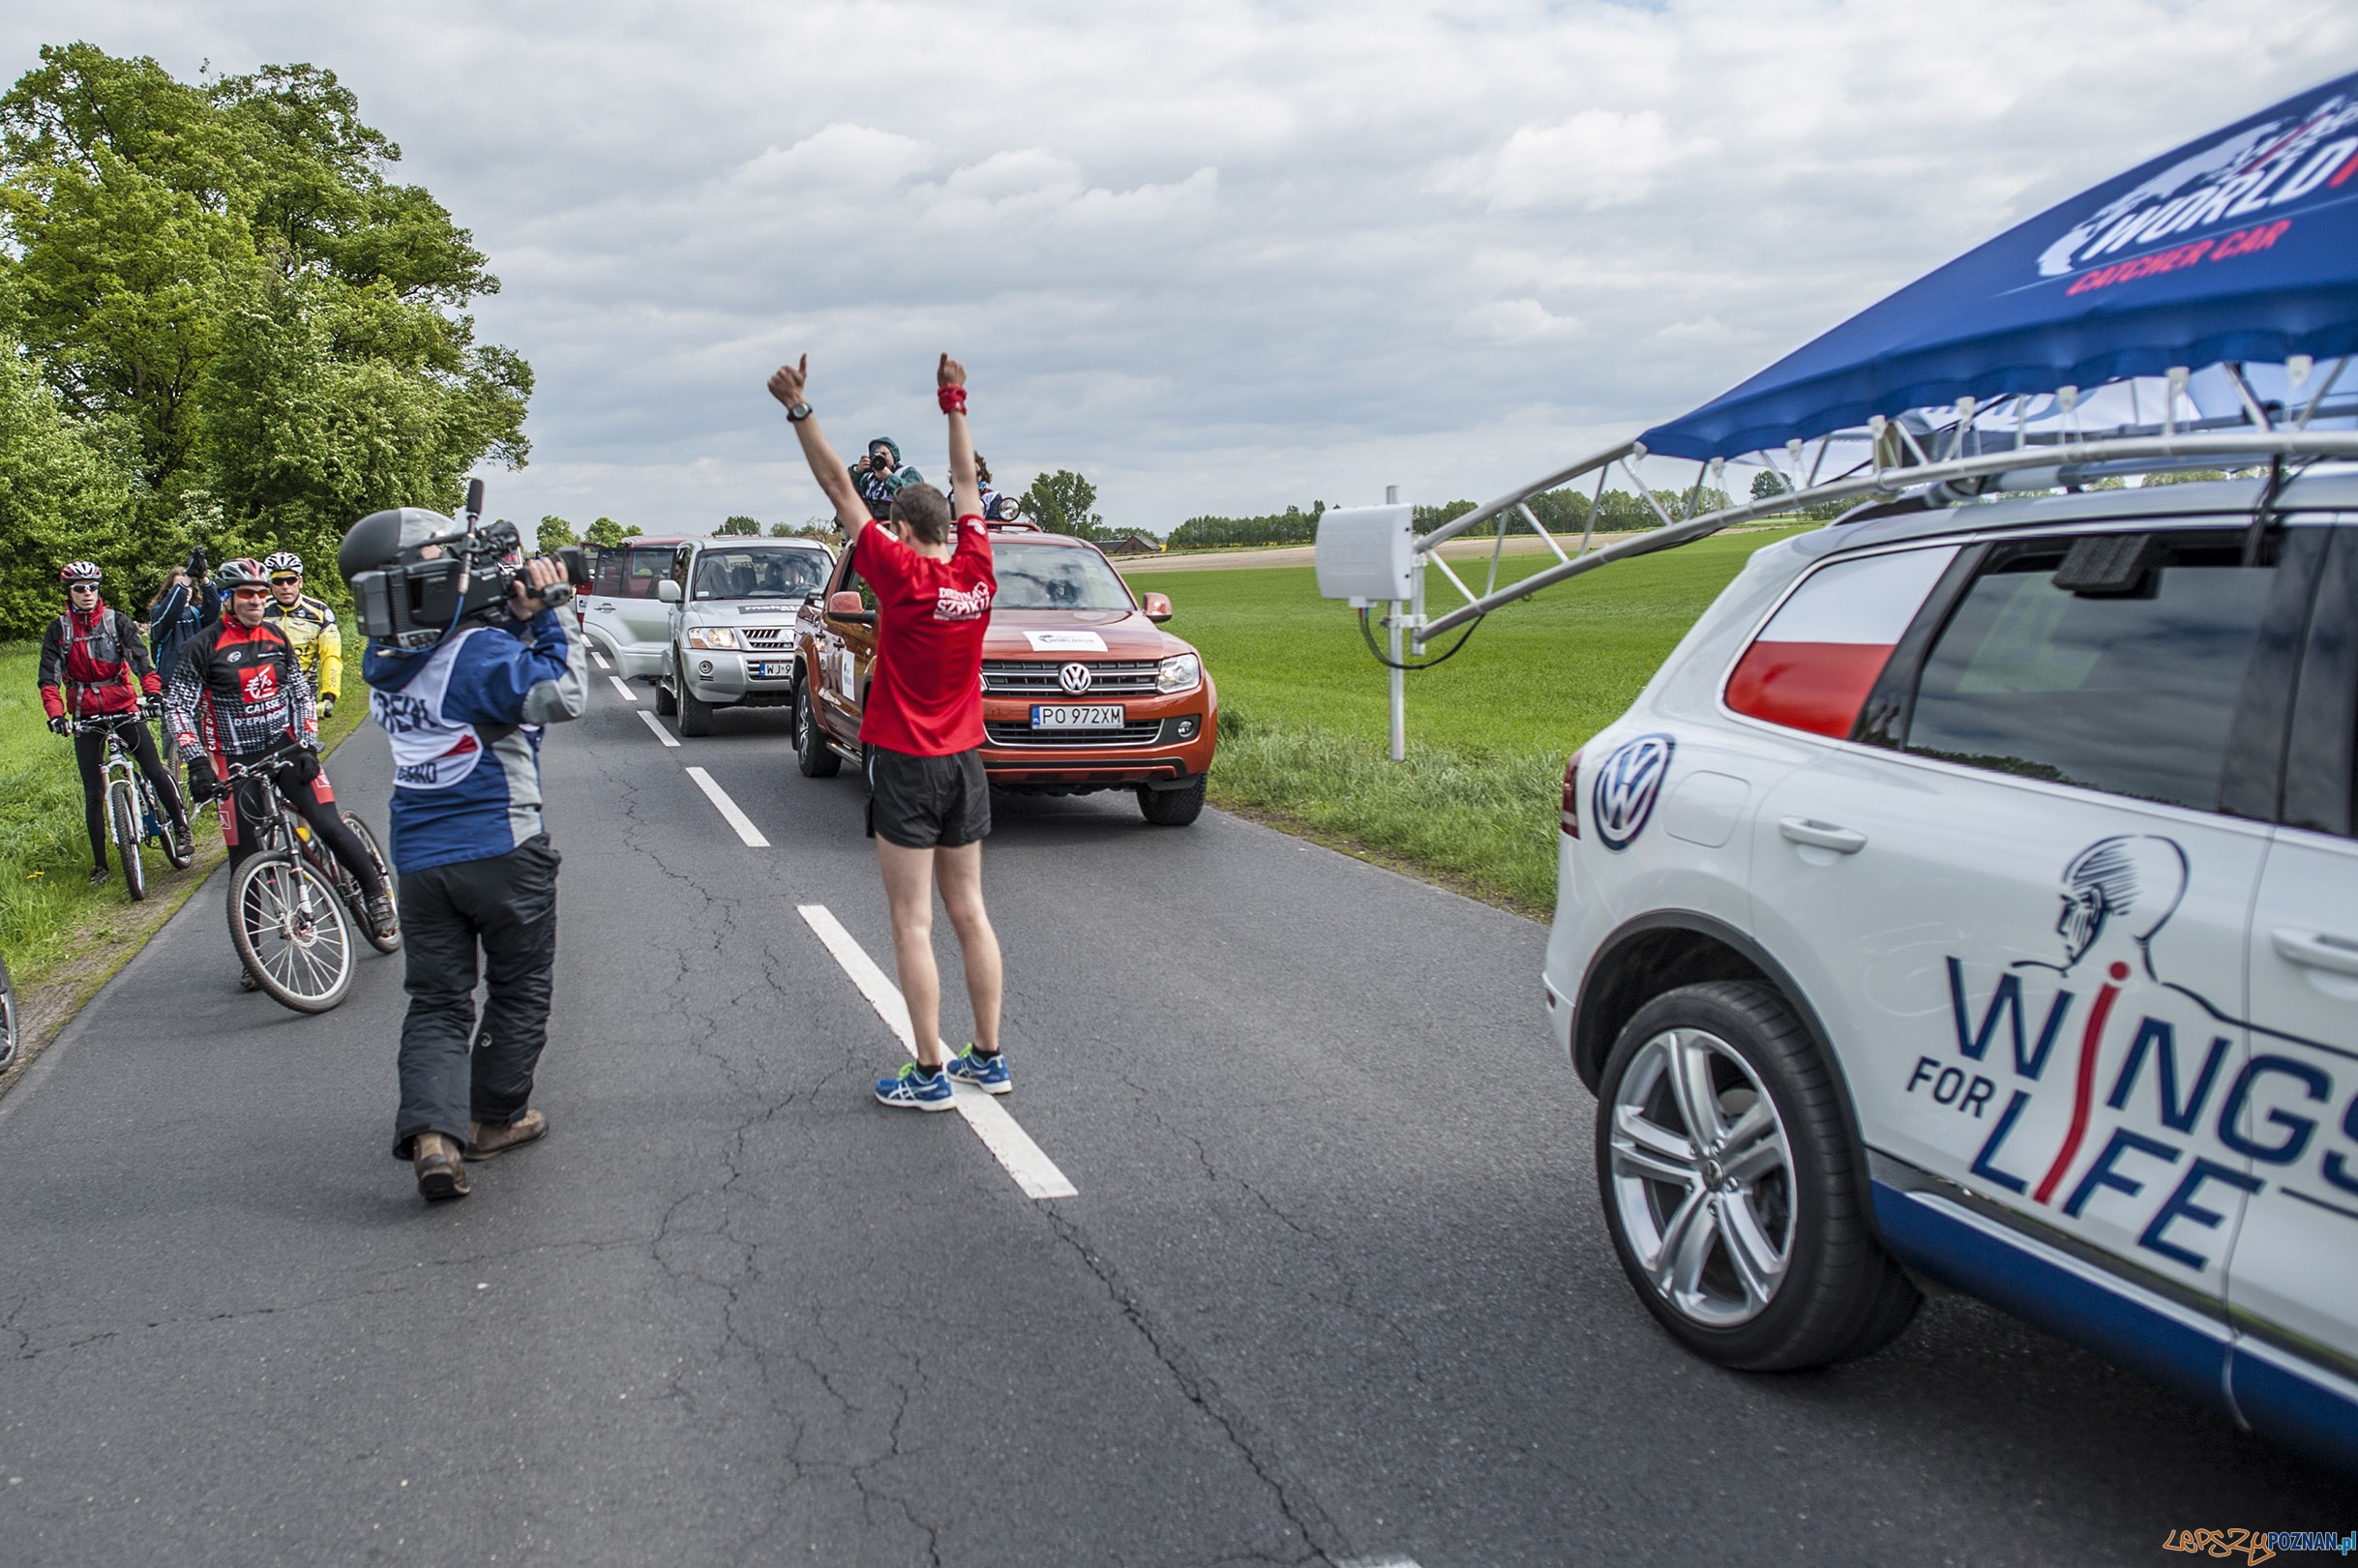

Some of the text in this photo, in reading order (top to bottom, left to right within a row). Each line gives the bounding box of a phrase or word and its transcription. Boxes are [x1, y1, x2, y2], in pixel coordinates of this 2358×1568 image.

[2079, 136, 2358, 261] WORLD
[2066, 219, 2292, 297] CATCHER CAR
[245, 698, 281, 714] CAISSE
[1043, 708, 1120, 725] PO 972XM
[1906, 1055, 1997, 1118] FOR
